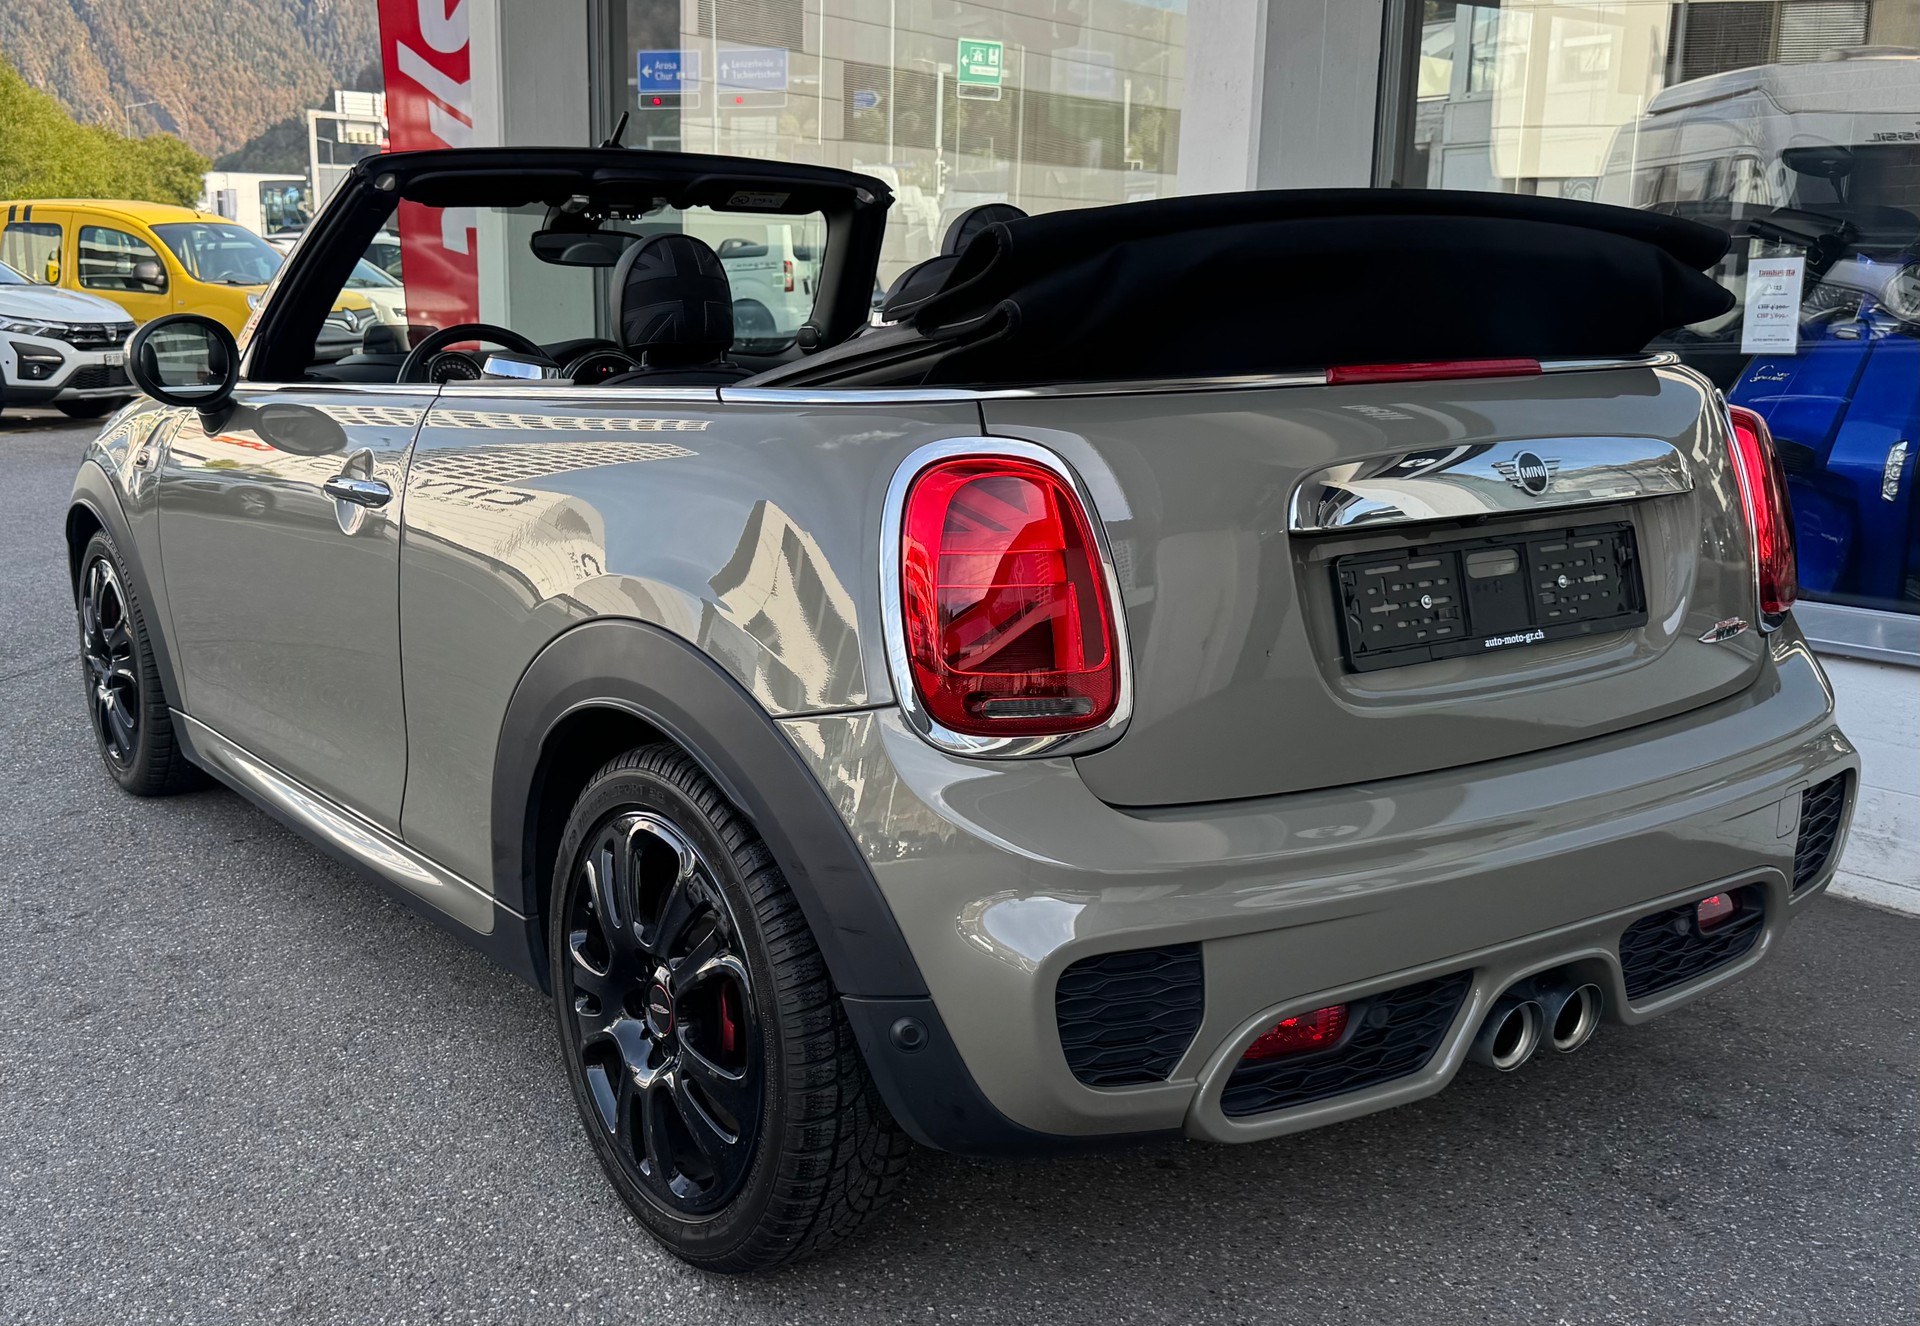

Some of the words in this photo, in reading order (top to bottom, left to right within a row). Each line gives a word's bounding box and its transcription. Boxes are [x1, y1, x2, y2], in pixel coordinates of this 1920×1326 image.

[654, 60, 677, 70] Arosa
[654, 71, 673, 81] Chur
[1520, 465, 1546, 479] MINI
[1484, 629, 1545, 648] auto-moto-gr.ch
